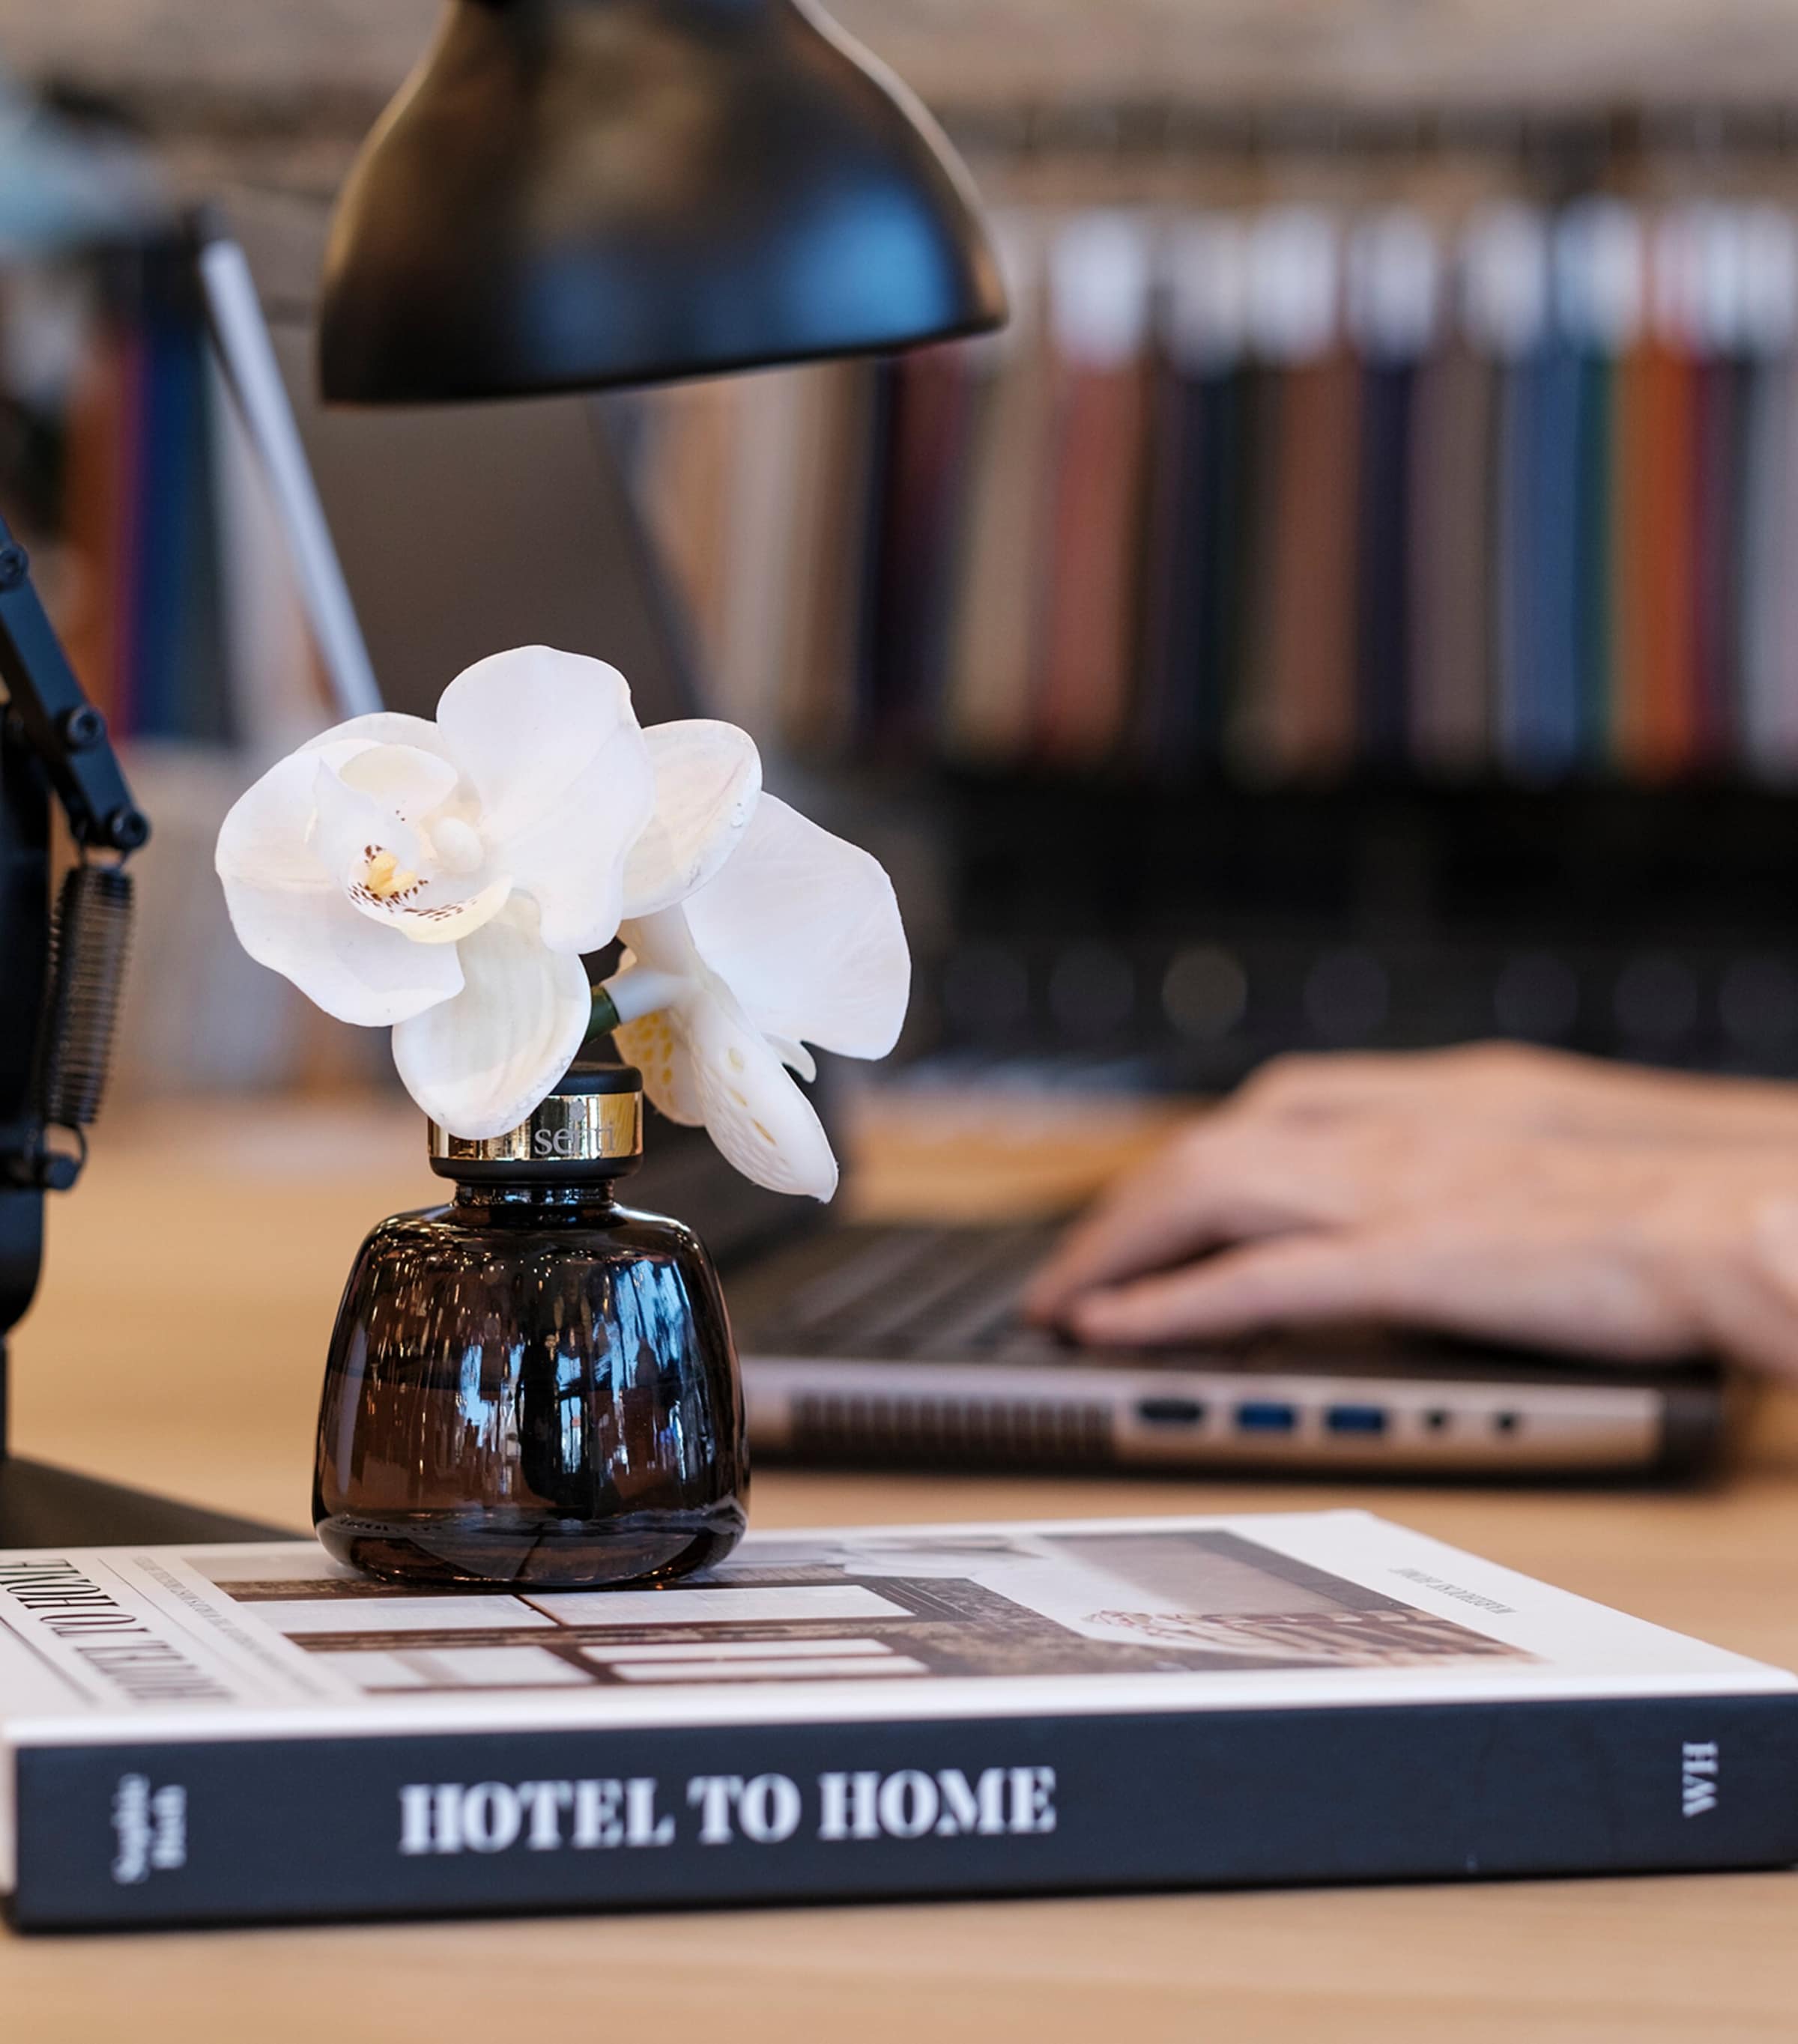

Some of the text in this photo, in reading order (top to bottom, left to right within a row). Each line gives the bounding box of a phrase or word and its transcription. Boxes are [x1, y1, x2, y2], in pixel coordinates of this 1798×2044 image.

[534, 1121, 616, 1156] senti
[0, 1559, 120, 1609] HOME
[39, 1613, 152, 1638] TO
[1683, 1742, 1718, 1816] WH
[399, 1766, 1057, 1855] HOTEL TO HOME
